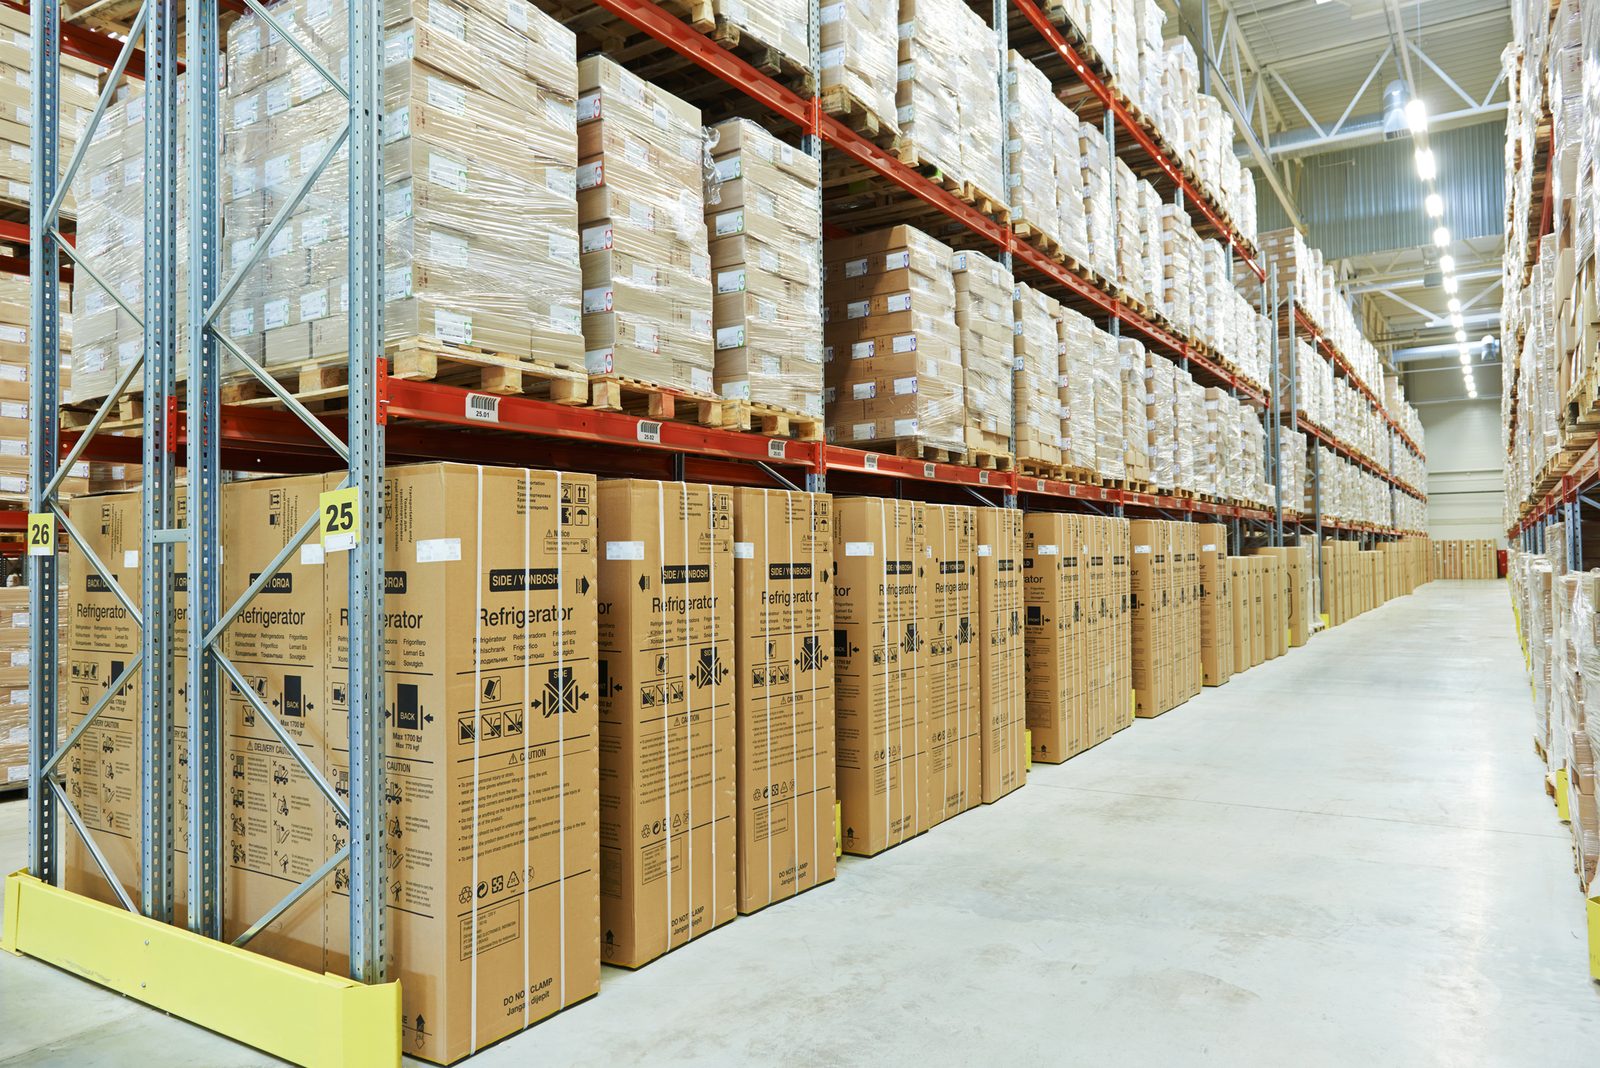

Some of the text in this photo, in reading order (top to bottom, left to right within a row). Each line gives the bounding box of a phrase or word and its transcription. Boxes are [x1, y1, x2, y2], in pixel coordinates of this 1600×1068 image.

[475, 410, 490, 419] 25.01
[325, 501, 354, 533] 25
[31, 523, 49, 545] 26
[492, 576, 512, 586] SIDE
[76, 602, 127, 621] Refrigerator
[286, 700, 299, 709] BACK
[400, 711, 416, 721] BACK
[404, 734, 415, 742] 1700
[386, 761, 411, 773] CAUTION
[503, 995, 514, 1006] DO
[530, 977, 553, 993] CLAMP
